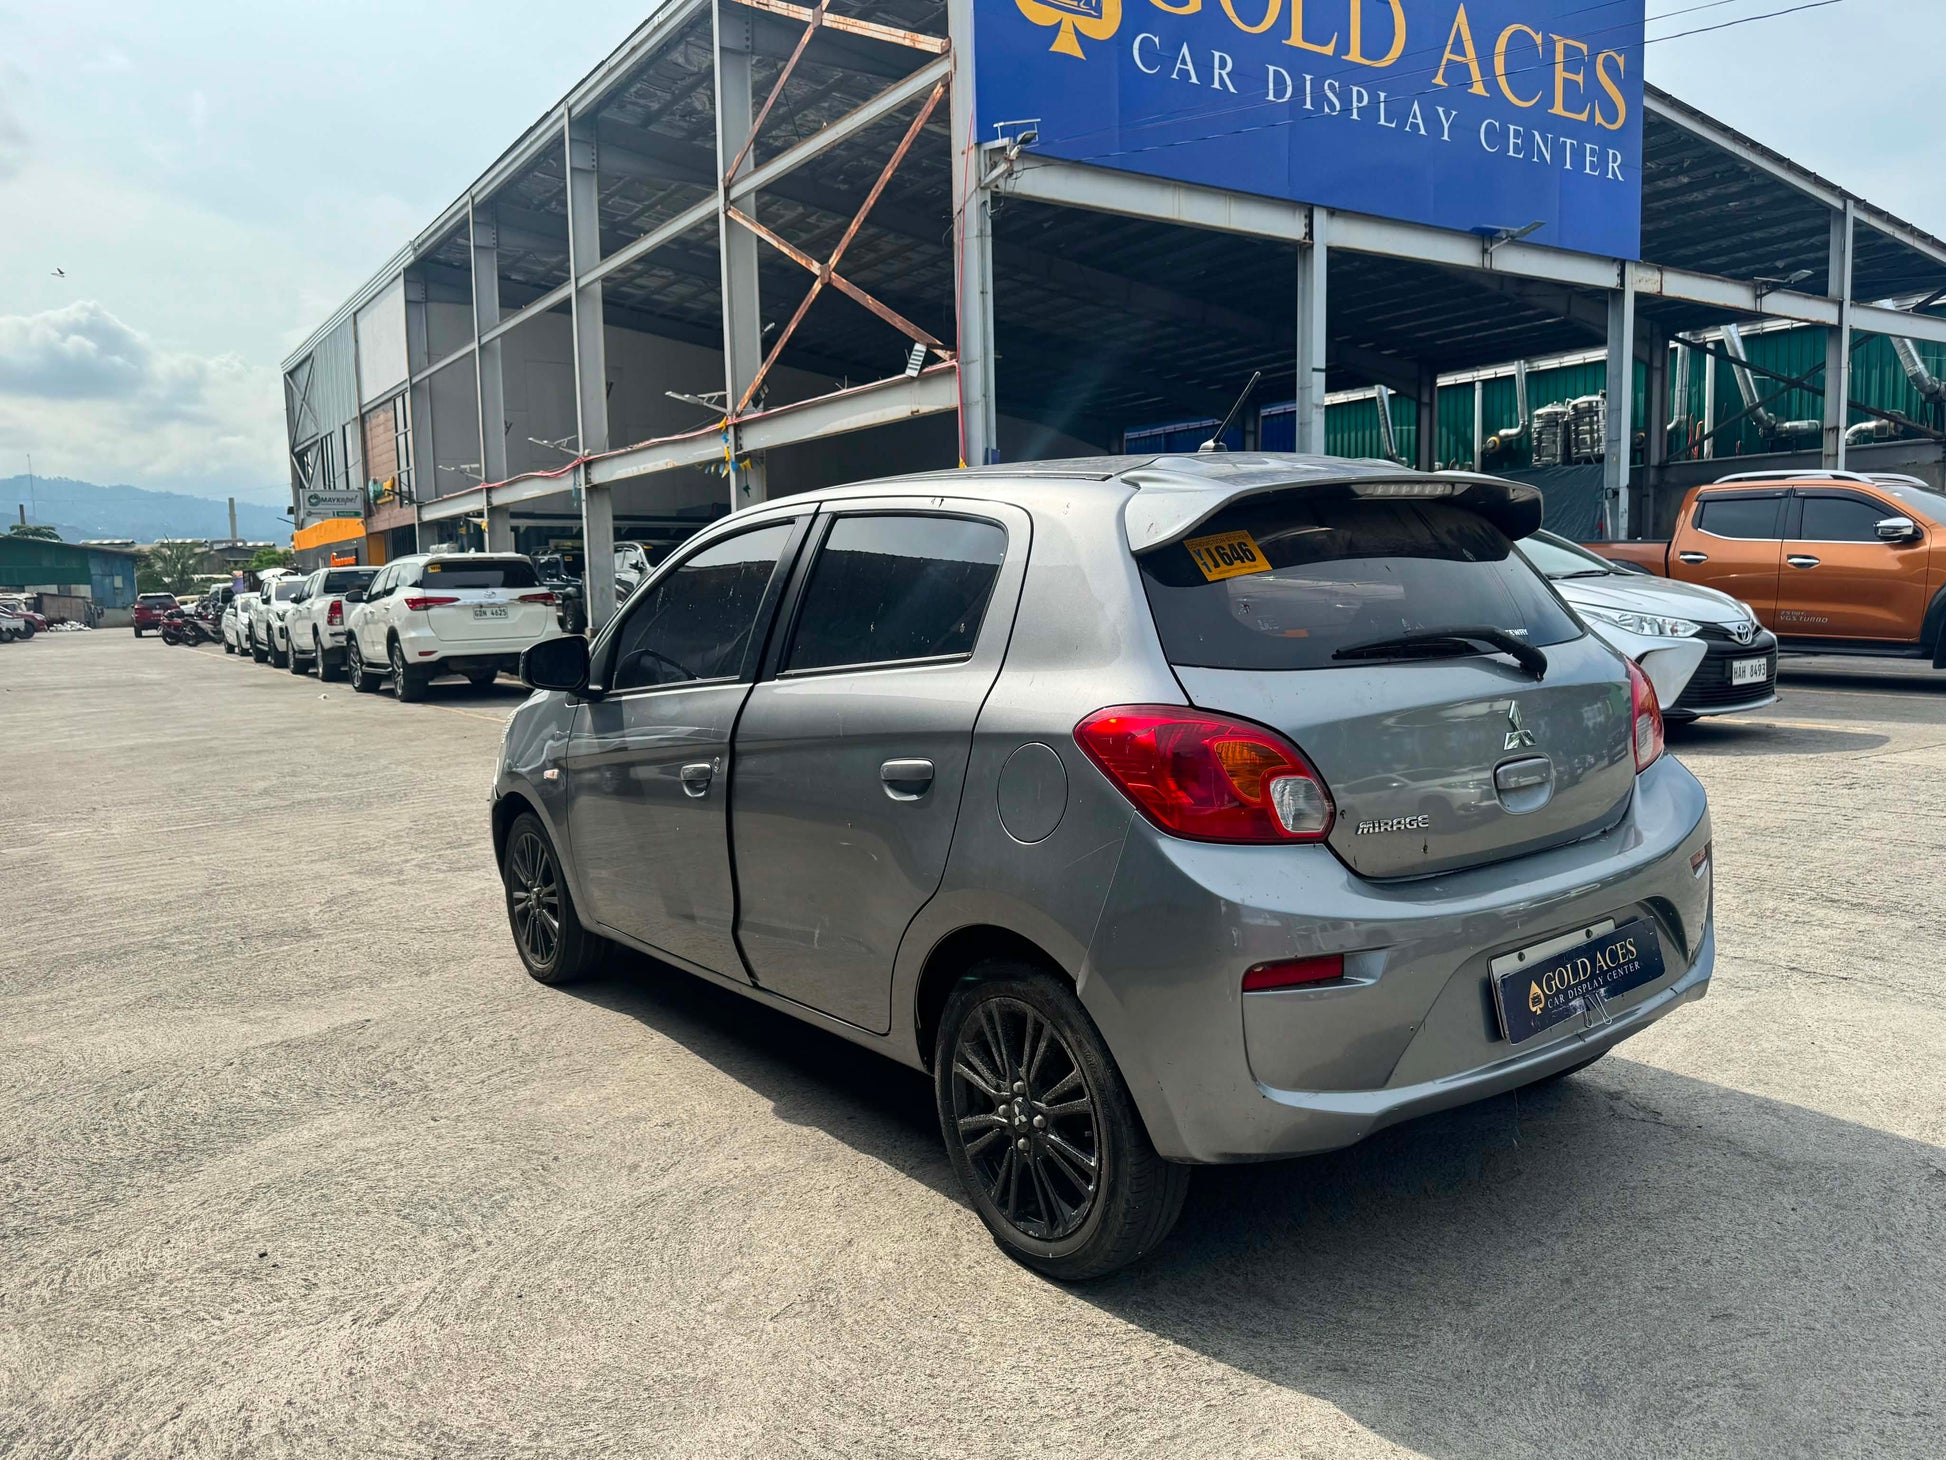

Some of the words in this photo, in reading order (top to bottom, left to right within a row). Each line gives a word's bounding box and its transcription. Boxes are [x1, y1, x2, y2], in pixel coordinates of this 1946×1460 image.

[1432, 2, 1626, 130] ACES
[1132, 33, 1238, 93] CAR
[1265, 64, 1458, 141] DISPLAY
[1480, 119, 1624, 181] CENTER
[1356, 814, 1429, 835] MIRAGE
[1542, 957, 1591, 995] GOLD
[1596, 938, 1637, 974] ACES
[1547, 993, 1565, 1009] CAR
[1567, 975, 1603, 999] DISPLAY
[1606, 961, 1640, 982] CENTER
